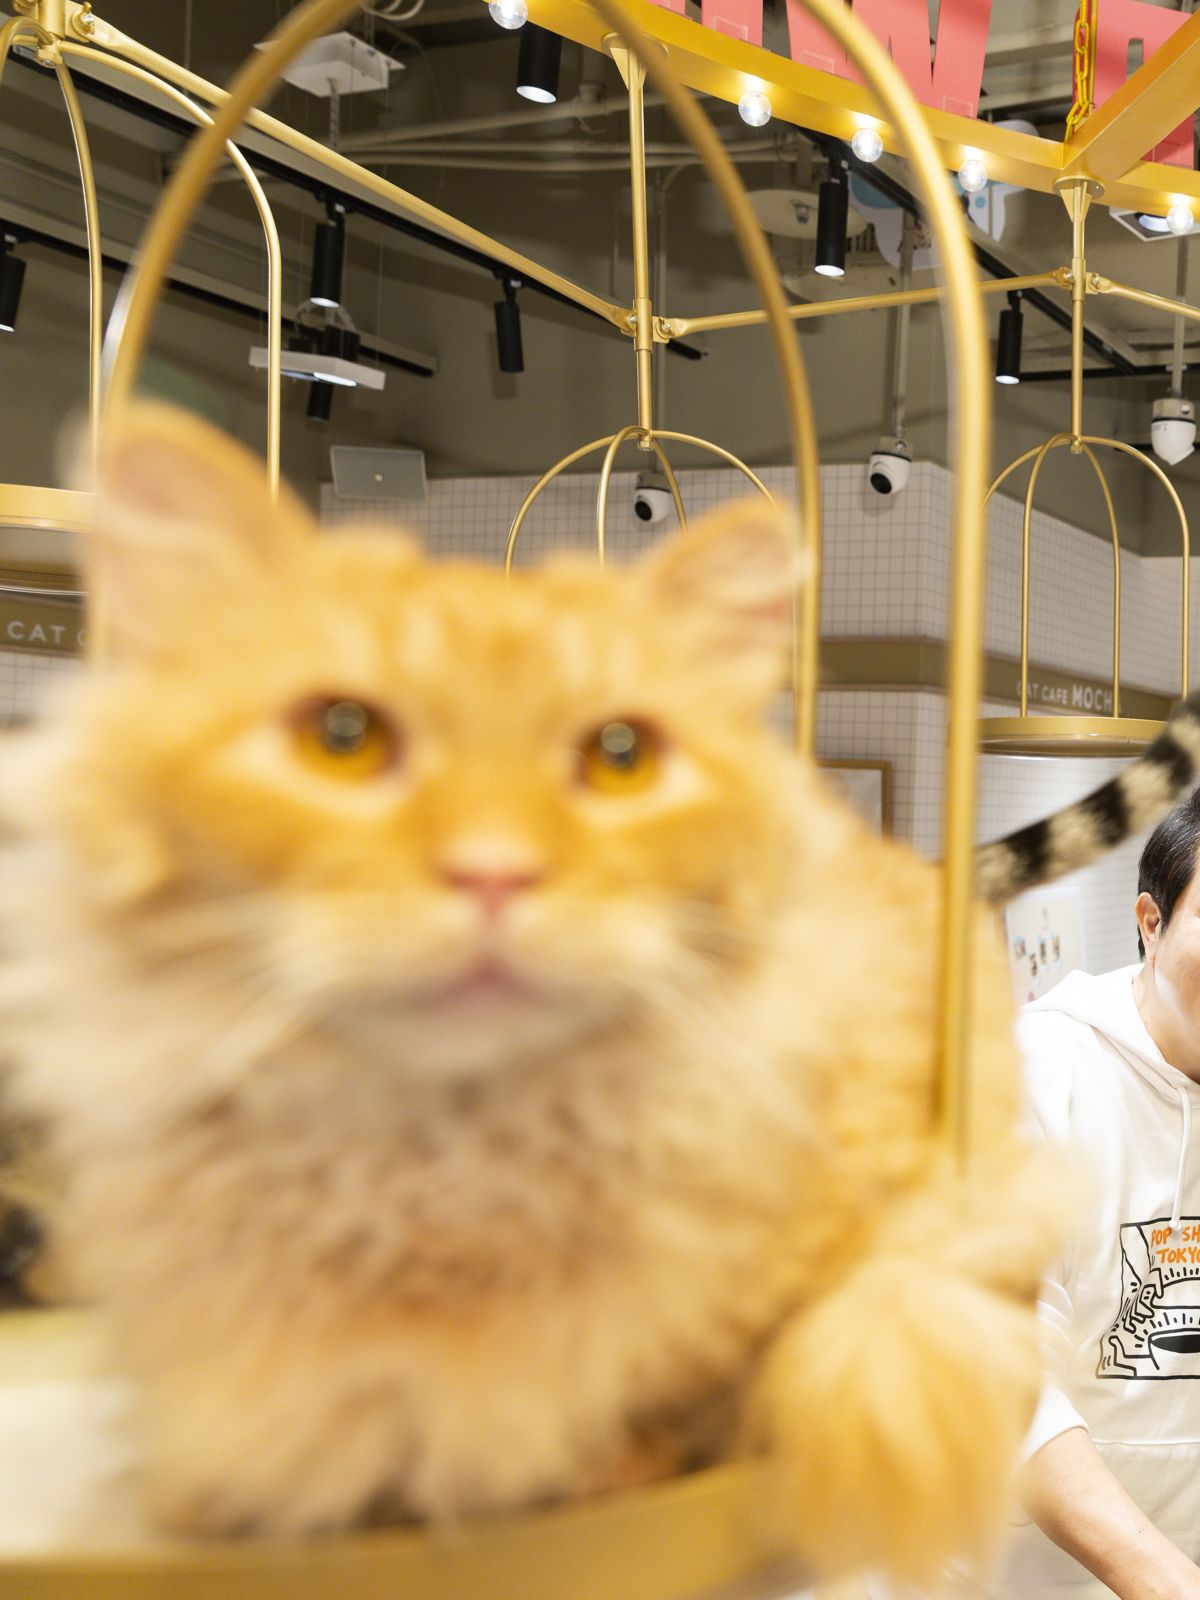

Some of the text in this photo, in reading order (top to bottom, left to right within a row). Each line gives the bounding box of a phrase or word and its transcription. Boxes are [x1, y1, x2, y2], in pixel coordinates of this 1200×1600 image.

[7, 620, 65, 644] CAT
[1041, 686, 1068, 705] CAFE
[1071, 683, 1122, 713] MOCH
[1151, 1226, 1173, 1248] POP
